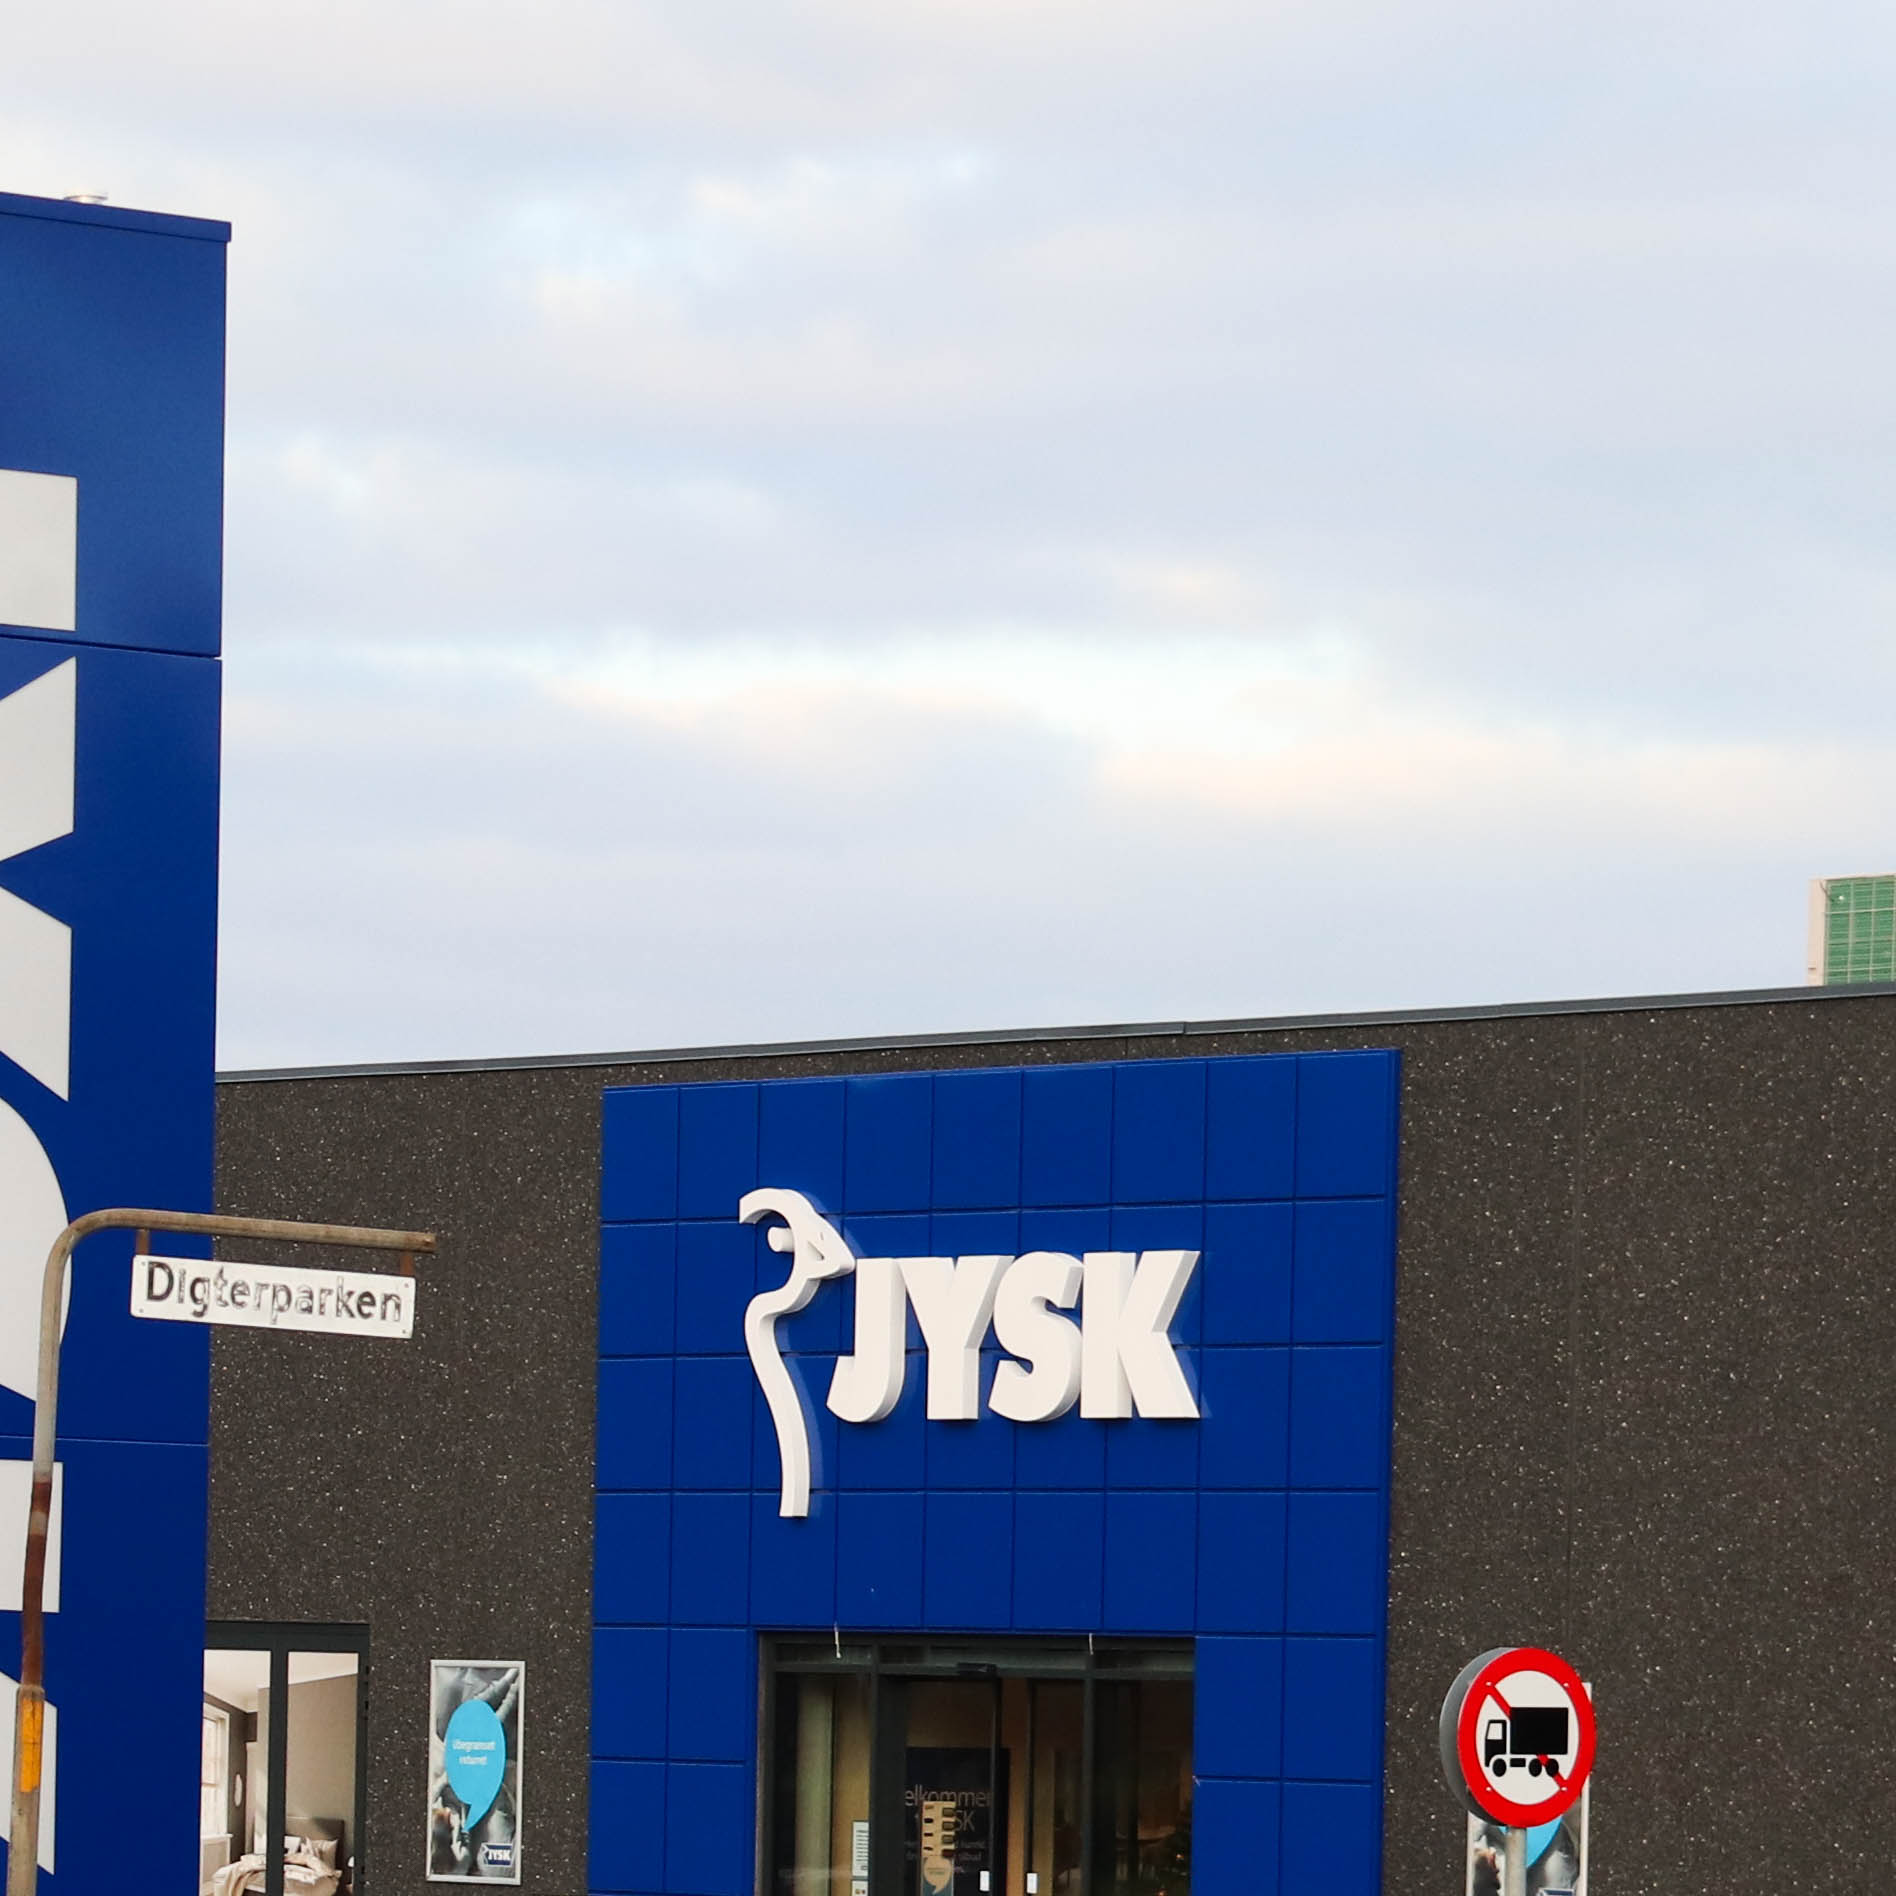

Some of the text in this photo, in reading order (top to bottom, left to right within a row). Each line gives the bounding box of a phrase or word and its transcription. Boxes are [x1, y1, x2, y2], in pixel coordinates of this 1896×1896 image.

[146, 1260, 401, 1325] Digterparken
[825, 1249, 1201, 1423] JYSK
[487, 1849, 512, 1861] JYSK
